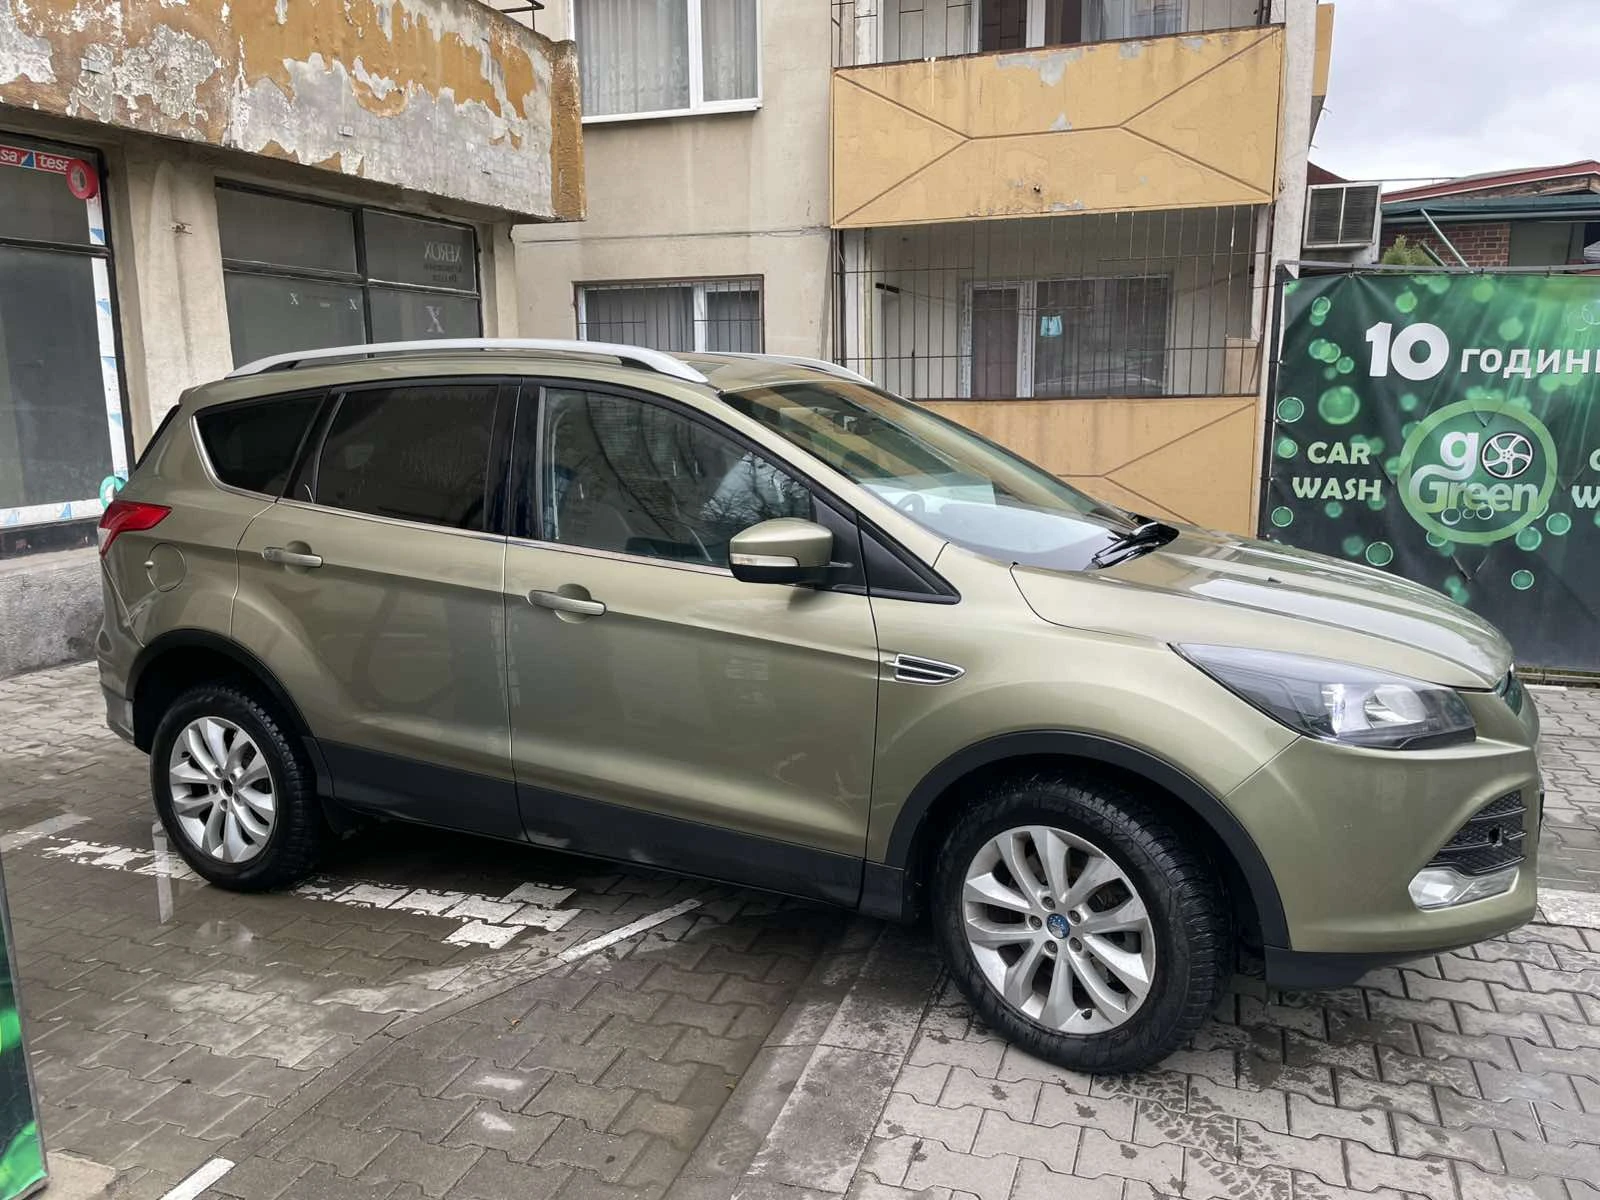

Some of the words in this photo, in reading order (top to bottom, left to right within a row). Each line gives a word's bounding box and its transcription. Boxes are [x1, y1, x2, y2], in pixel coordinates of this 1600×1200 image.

[1365, 321, 1450, 381] 10
[1307, 441, 1371, 465] CAR
[1292, 477, 1382, 501] WASH
[1408, 476, 1540, 514] Green
